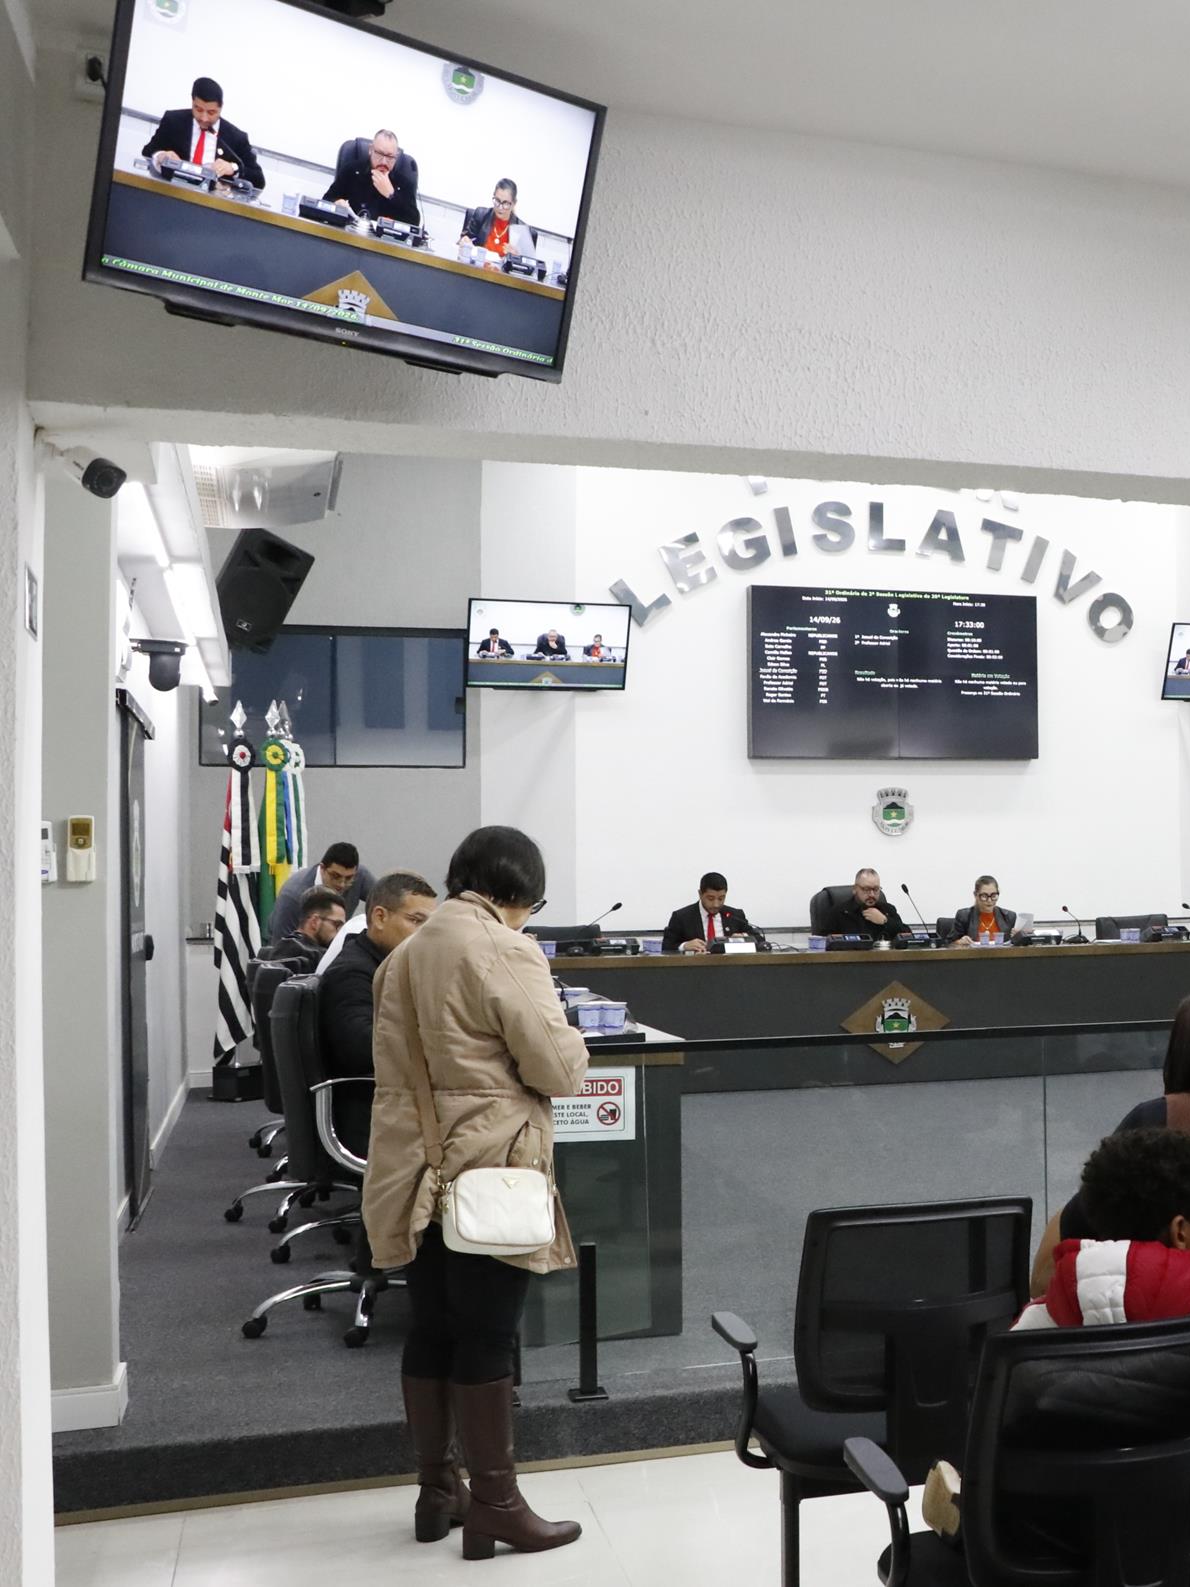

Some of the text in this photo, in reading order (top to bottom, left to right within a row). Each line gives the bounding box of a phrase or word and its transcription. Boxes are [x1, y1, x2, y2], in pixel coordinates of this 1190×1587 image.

[112, 258, 159, 275] Câmara
[161, 270, 218, 288] Municipal
[236, 286, 270, 300] Monte
[272, 295, 293, 306] Mor
[335, 328, 360, 337] SONY
[472, 340, 502, 352] Sessão
[502, 348, 545, 363] Ordinária
[608, 500, 1136, 643] LEGISLATIVO
[955, 621, 985, 629] 17:33:00
[582, 1081, 619, 1094] BIDO
